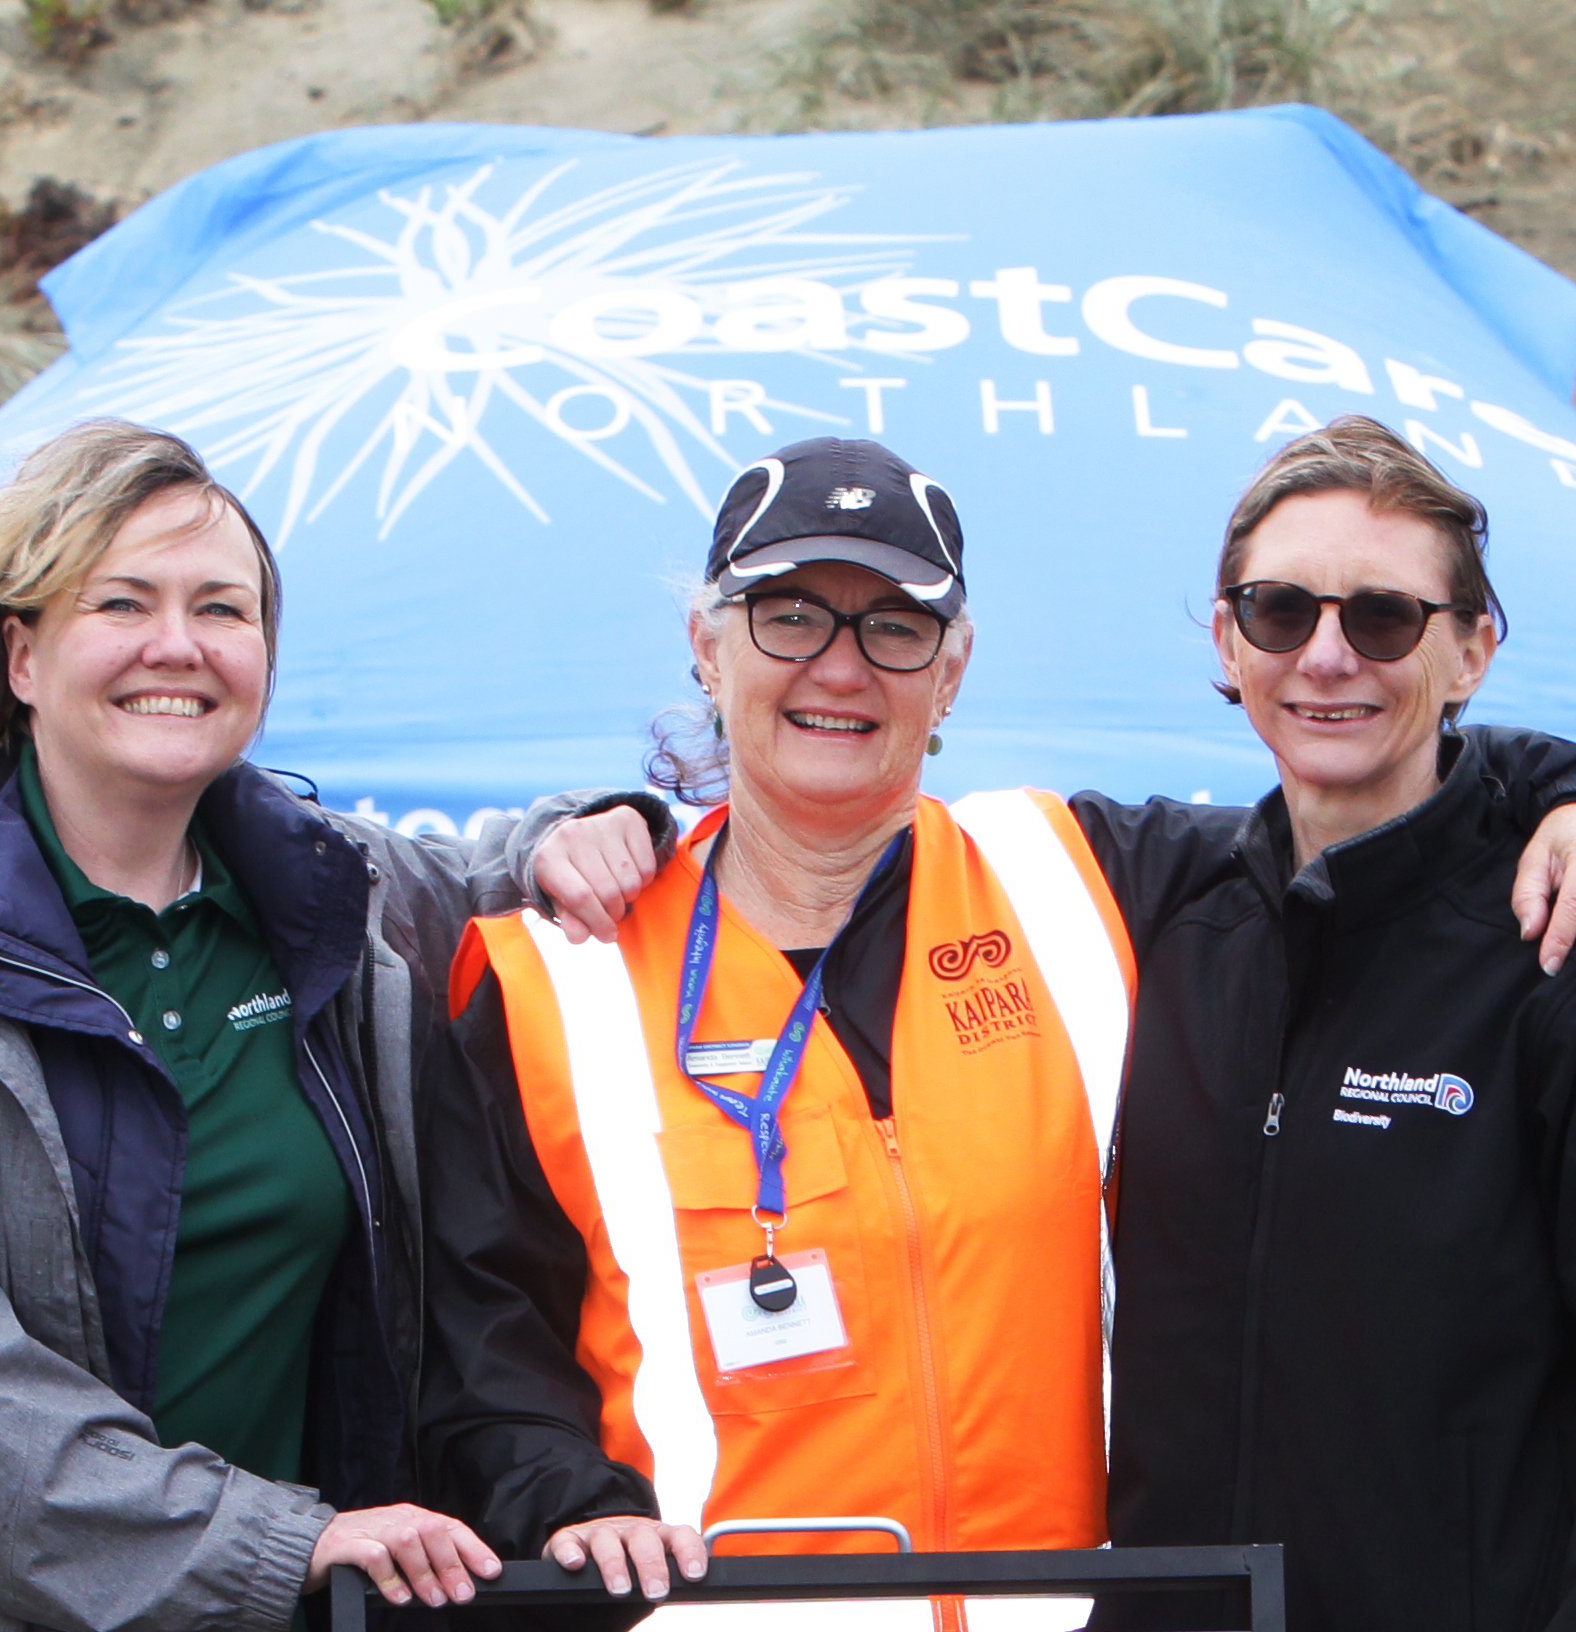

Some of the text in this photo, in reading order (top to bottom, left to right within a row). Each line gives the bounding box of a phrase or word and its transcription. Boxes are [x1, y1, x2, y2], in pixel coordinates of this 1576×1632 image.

[227, 987, 292, 1021] Northland
[1343, 1066, 1440, 1093] Northland
[1340, 1086, 1433, 1106] REGIONAL COUNCIL
[1332, 1108, 1392, 1130] Biodiversity
